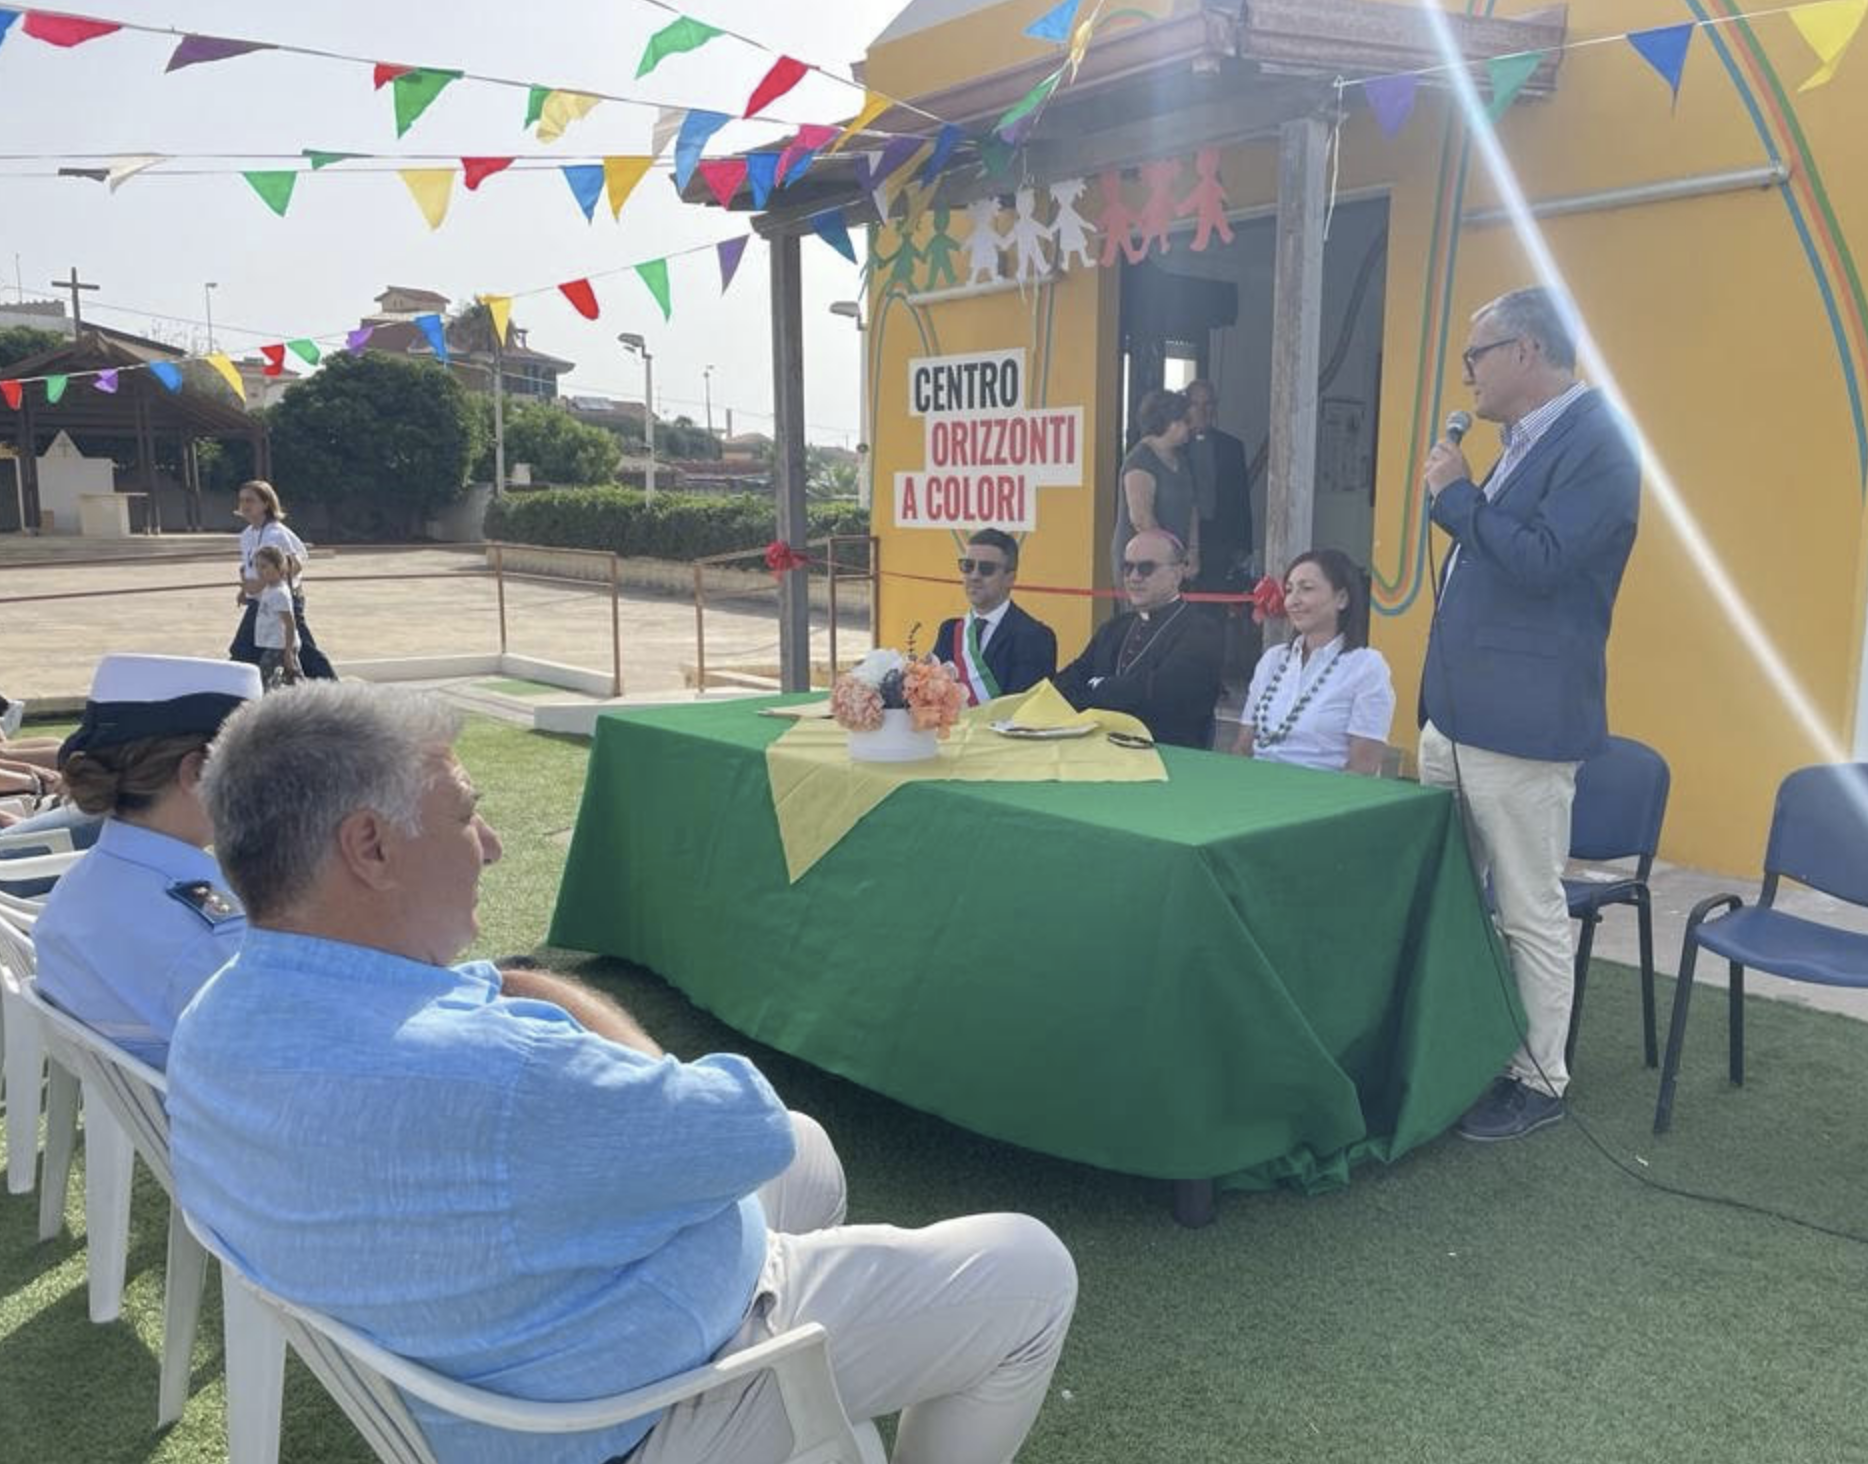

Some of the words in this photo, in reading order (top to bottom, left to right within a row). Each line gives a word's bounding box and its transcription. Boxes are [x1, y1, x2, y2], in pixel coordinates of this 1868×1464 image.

[915, 358, 1019, 412] CENTRO
[932, 415, 1075, 466] ORIZZONTI
[902, 476, 918, 519] A
[926, 475, 1025, 521] COLORI
